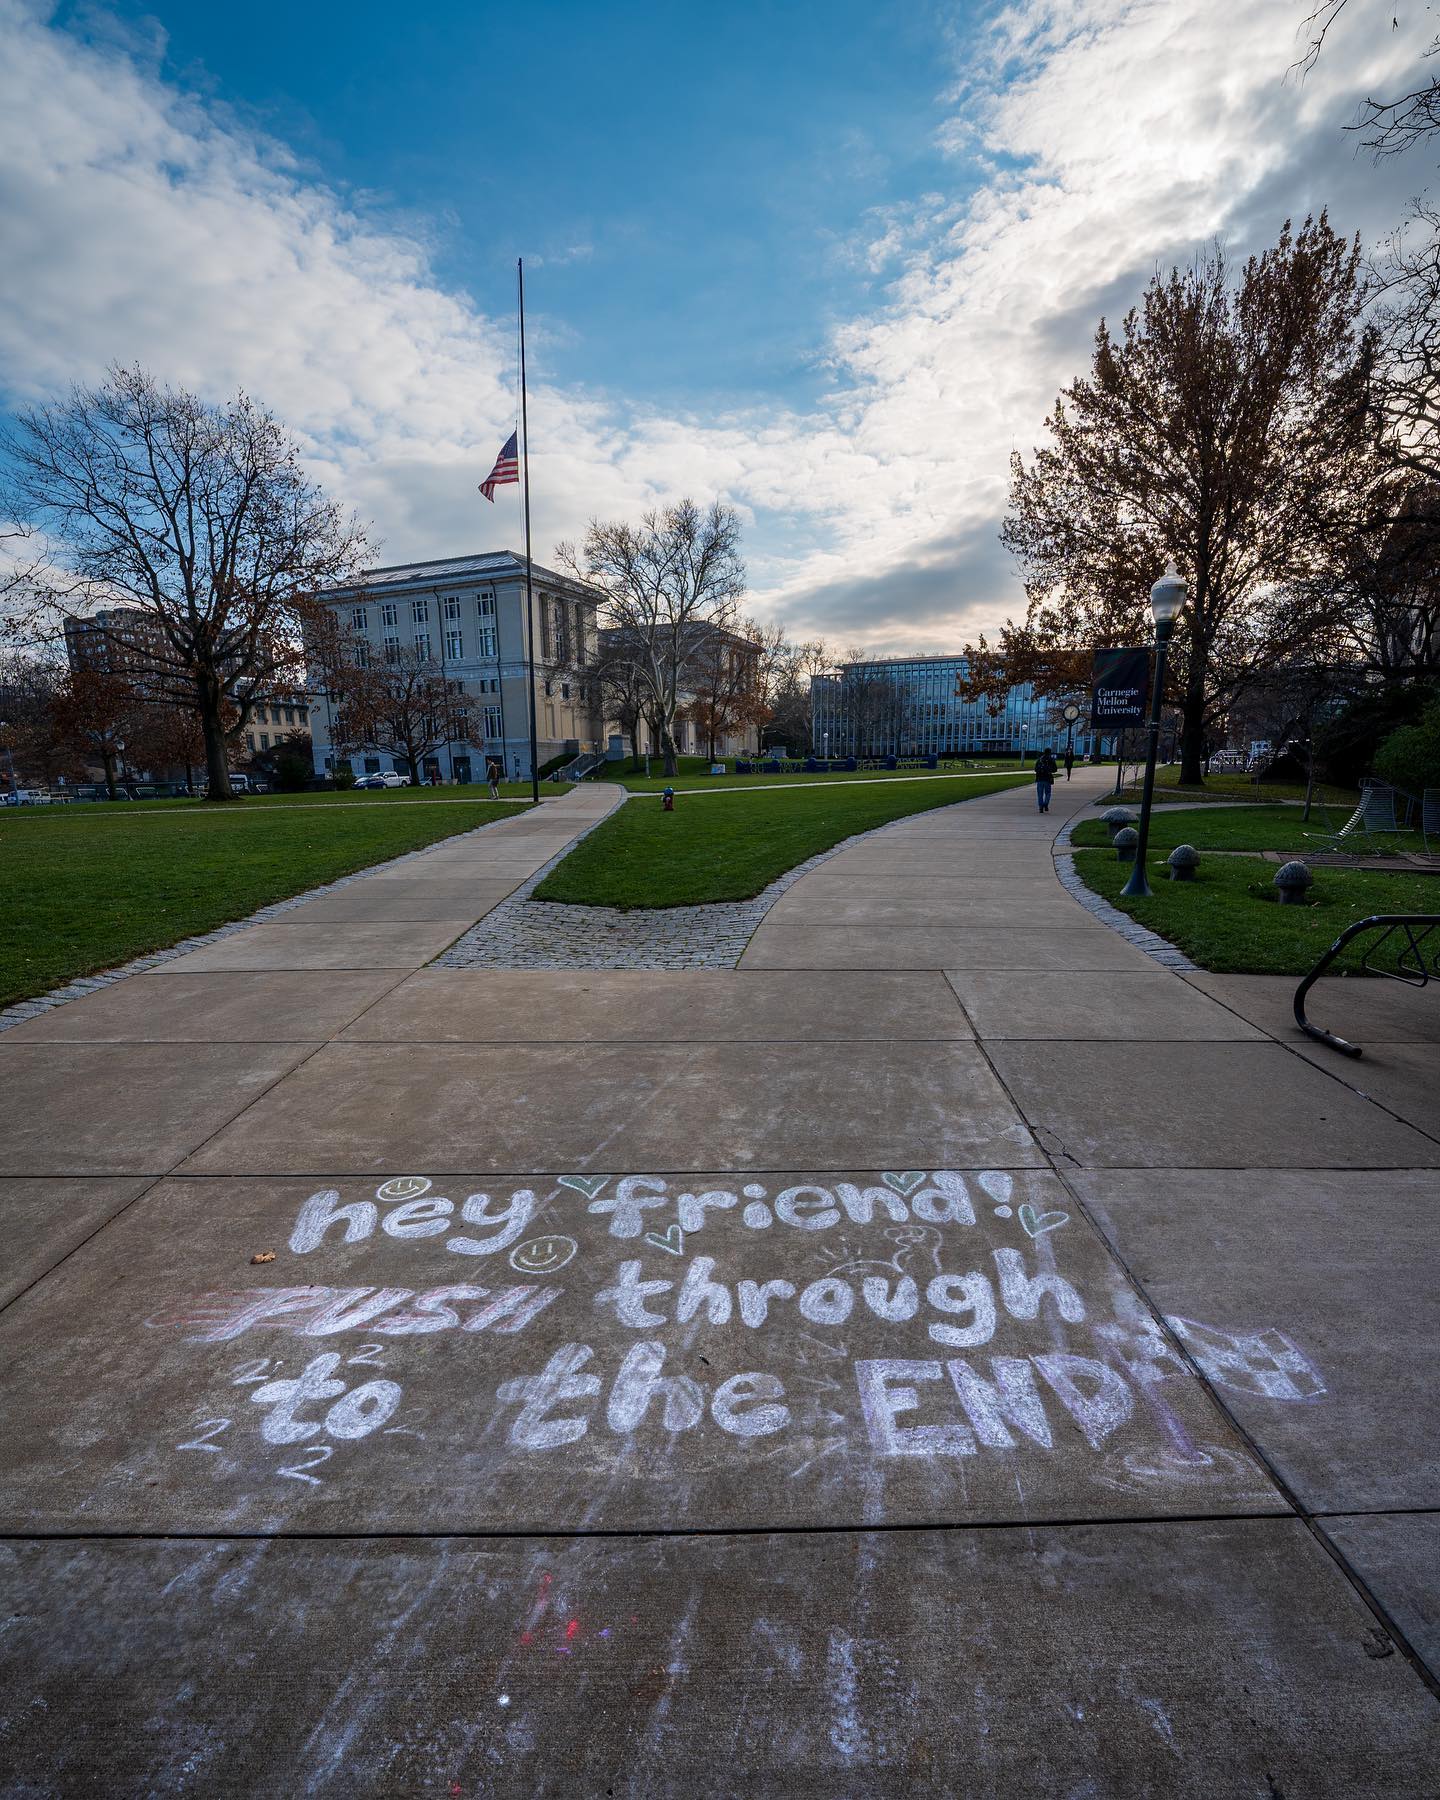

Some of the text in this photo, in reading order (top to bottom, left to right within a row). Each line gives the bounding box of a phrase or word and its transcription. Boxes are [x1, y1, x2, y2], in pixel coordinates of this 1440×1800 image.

[1097, 688, 1139, 698] Carnegie
[1097, 697, 1128, 706] Mellon
[1097, 705, 1142, 716] University
[288, 1170, 1013, 1256] hey friend!
[595, 1248, 1086, 1349] through
[250, 1340, 1136, 1454] to the END
